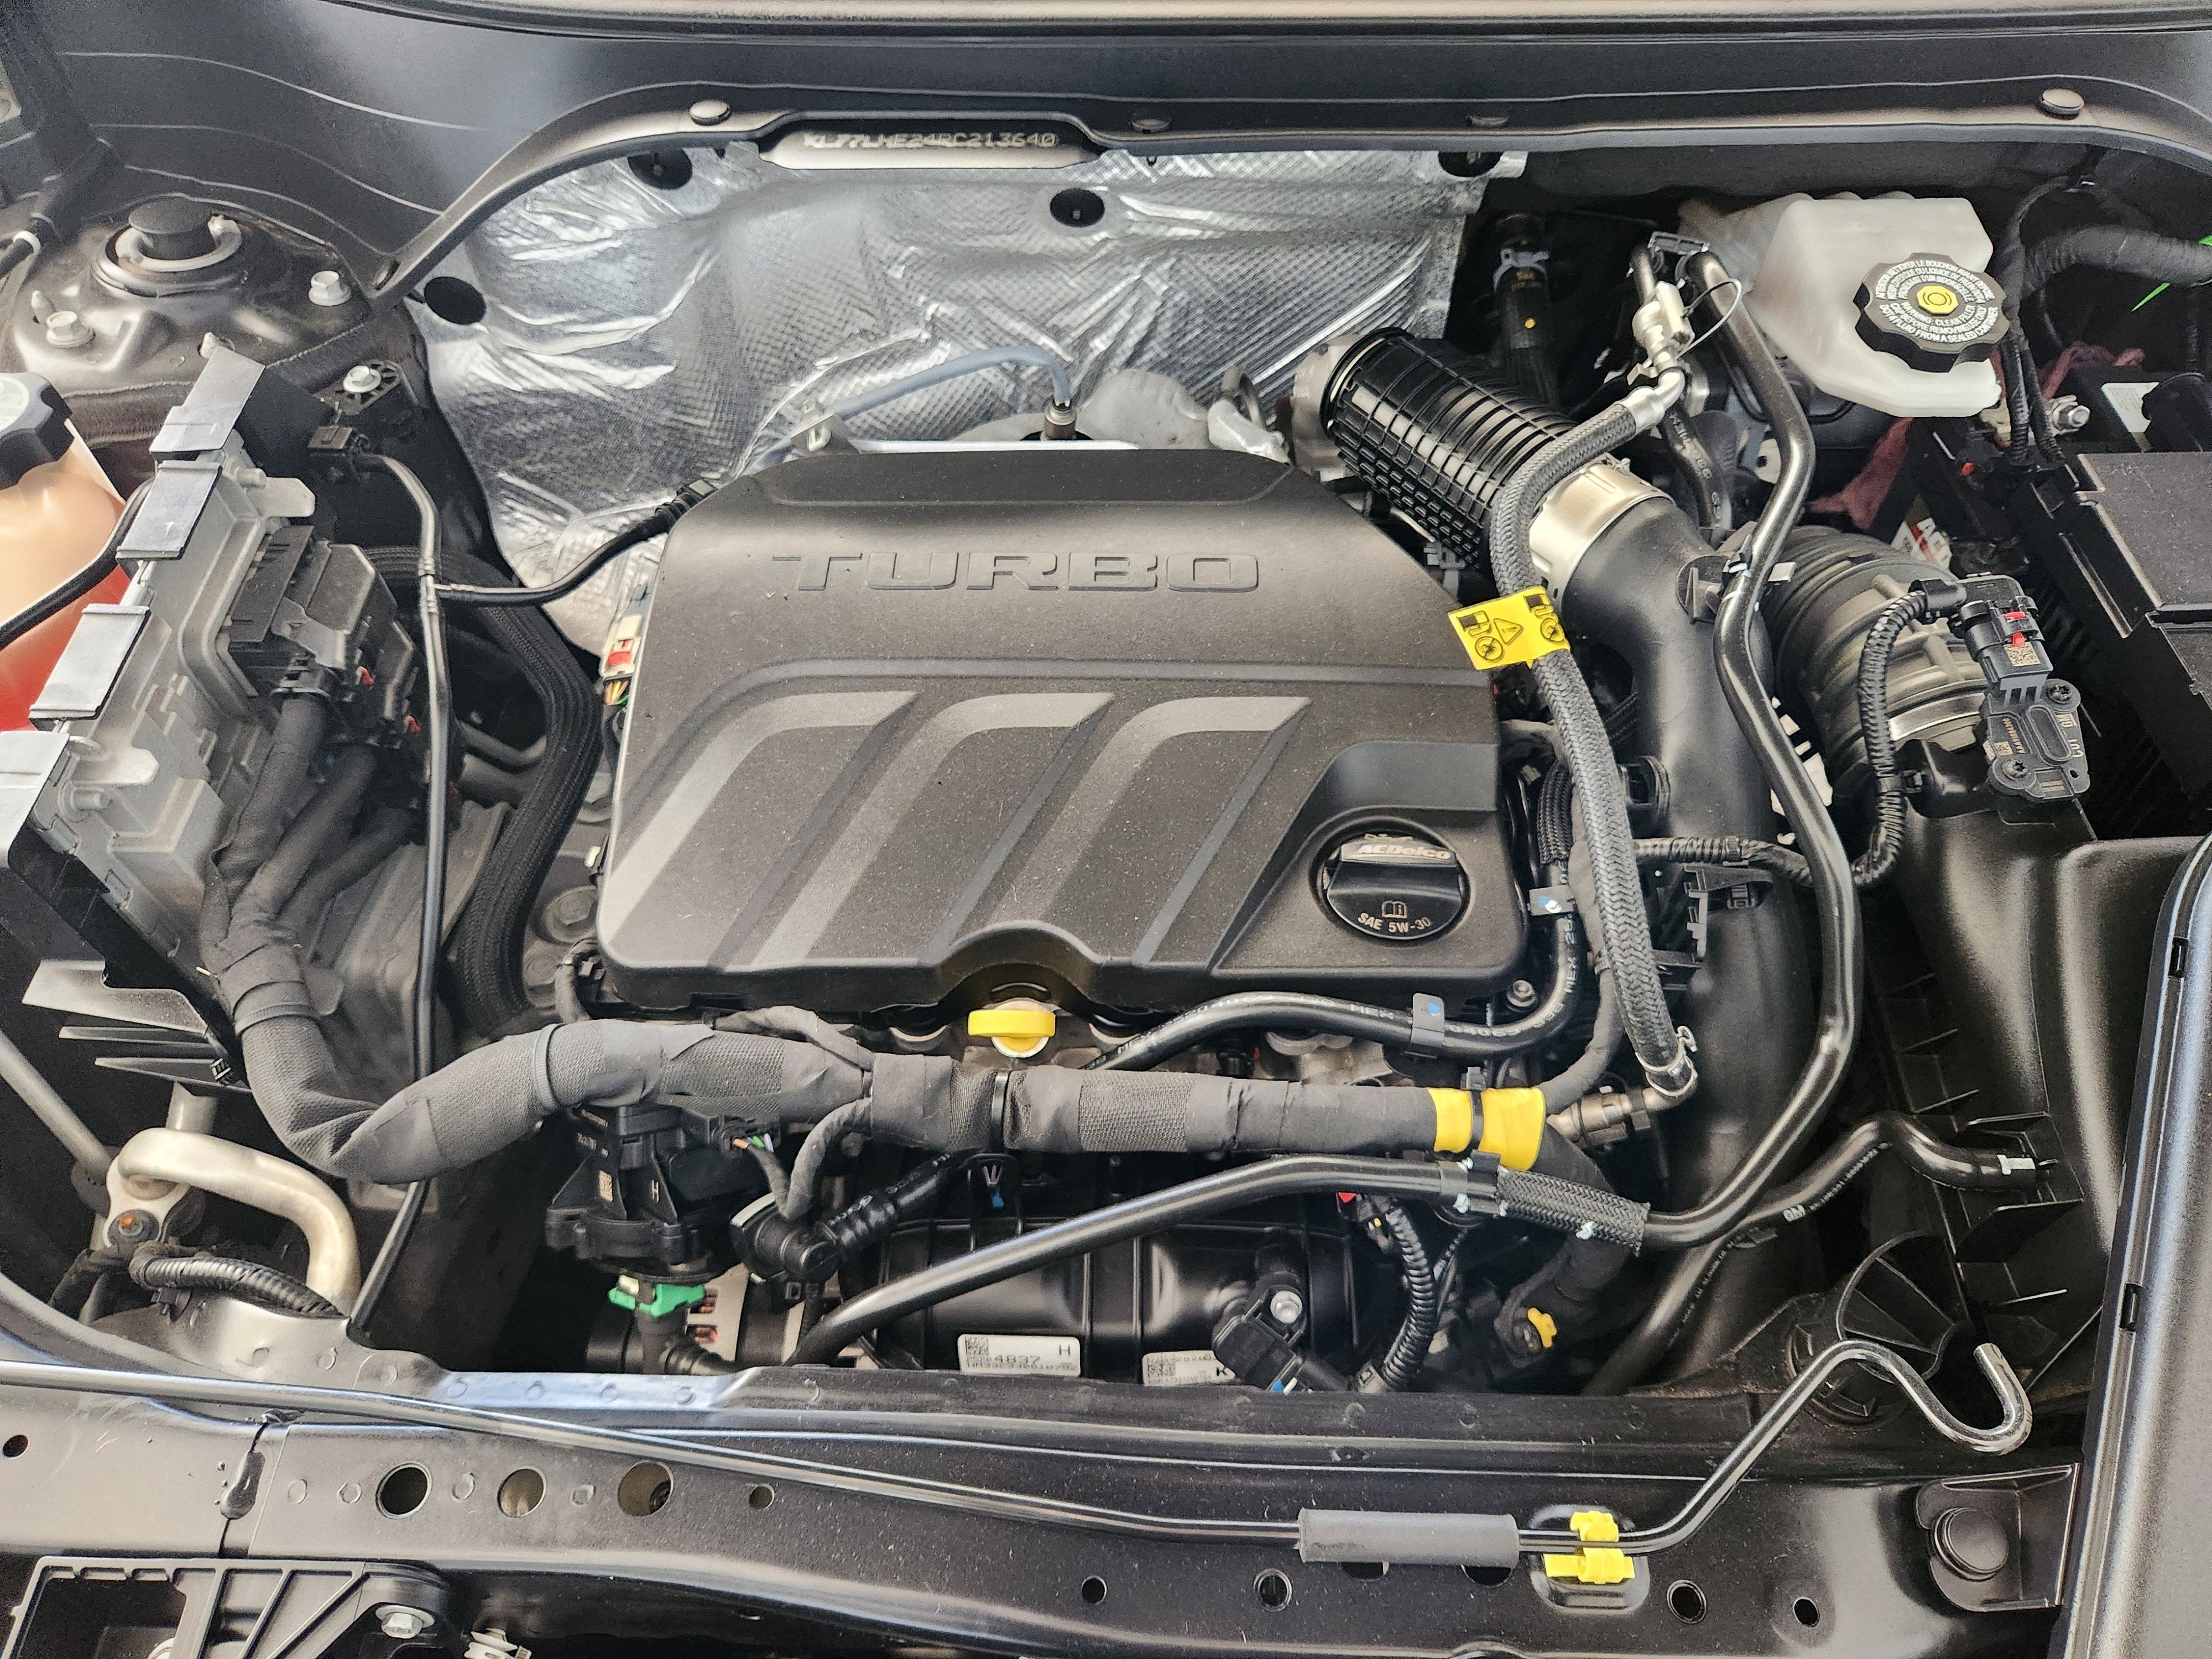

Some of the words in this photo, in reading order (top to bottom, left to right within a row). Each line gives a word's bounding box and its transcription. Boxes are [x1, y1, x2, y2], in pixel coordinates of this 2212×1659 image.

[773, 552, 1259, 592] TURBO
[1357, 844, 1451, 860] ACDelco
[1358, 913, 1383, 930] SAE
[1389, 917, 1431, 933] 5W-30
[1058, 1344, 1072, 1357] H
